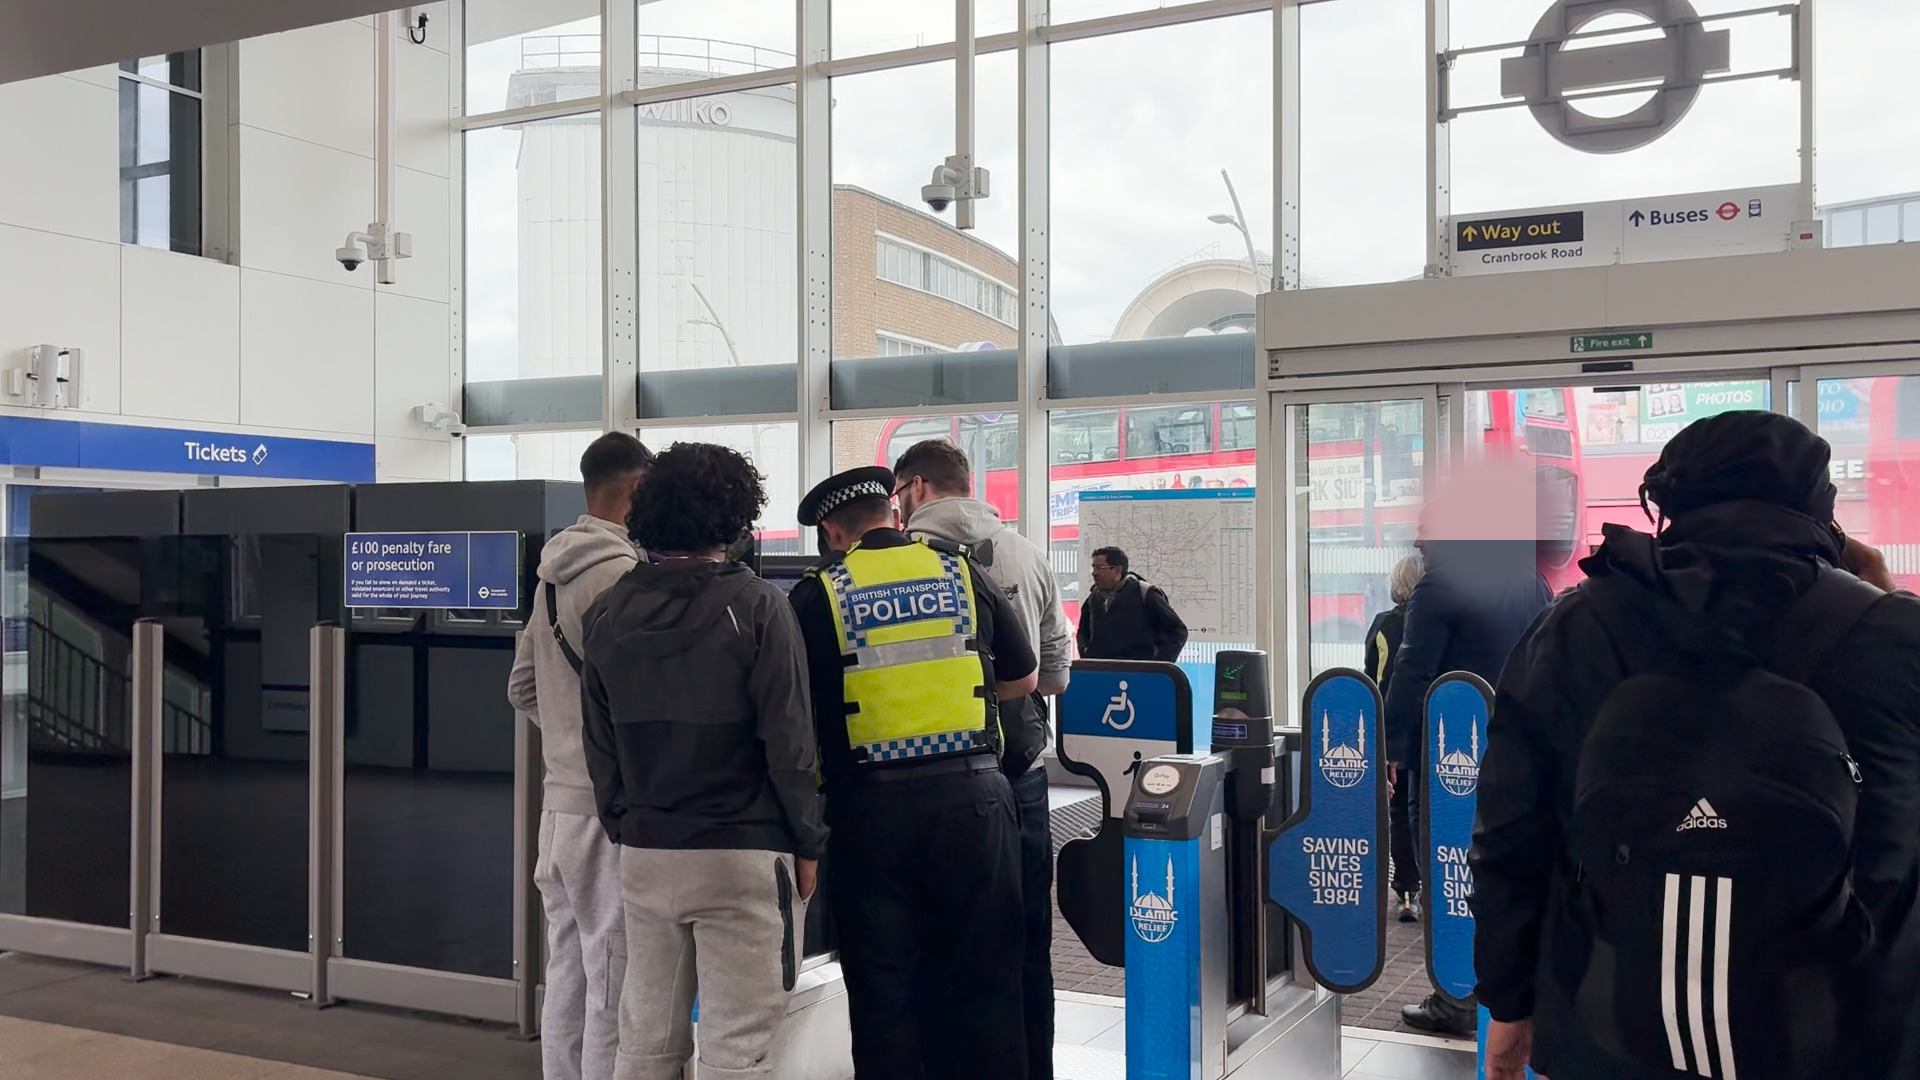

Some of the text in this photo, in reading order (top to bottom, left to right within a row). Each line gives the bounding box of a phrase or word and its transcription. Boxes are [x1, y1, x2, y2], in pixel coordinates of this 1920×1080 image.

[1649, 209, 1708, 226] Buses
[1481, 220, 1561, 241] Way out
[1481, 247, 1583, 264] Cranbrook Road
[1590, 337, 1631, 348] Fire exit
[1696, 390, 1753, 406] PHOTOS
[184, 441, 247, 463] Tickets
[1829, 459, 1865, 479] EE
[352, 540, 452, 557] £100 penalty fare
[352, 558, 435, 574] or prosecution
[852, 582, 950, 603] BRITISH TRANSPORT
[853, 592, 956, 625] POLICE
[1318, 758, 1369, 769] ISLAMIC
[1329, 771, 1360, 779] RELIEF
[1445, 778, 1473, 787] RELIEF
[1676, 815, 1728, 832] adidas
[1302, 836, 1369, 856] SAVING
[1437, 845, 1469, 864] SAV
[1310, 854, 1361, 872] LIVES
[1308, 870, 1363, 889] SINCE
[1444, 863, 1473, 883] LIV
[1312, 888, 1360, 906] 1984
[1443, 881, 1474, 899] SIN
[1129, 906, 1179, 921] ISLAMIC
[1446, 899, 1474, 918] 19
[1138, 922, 1168, 932] RELIEF
